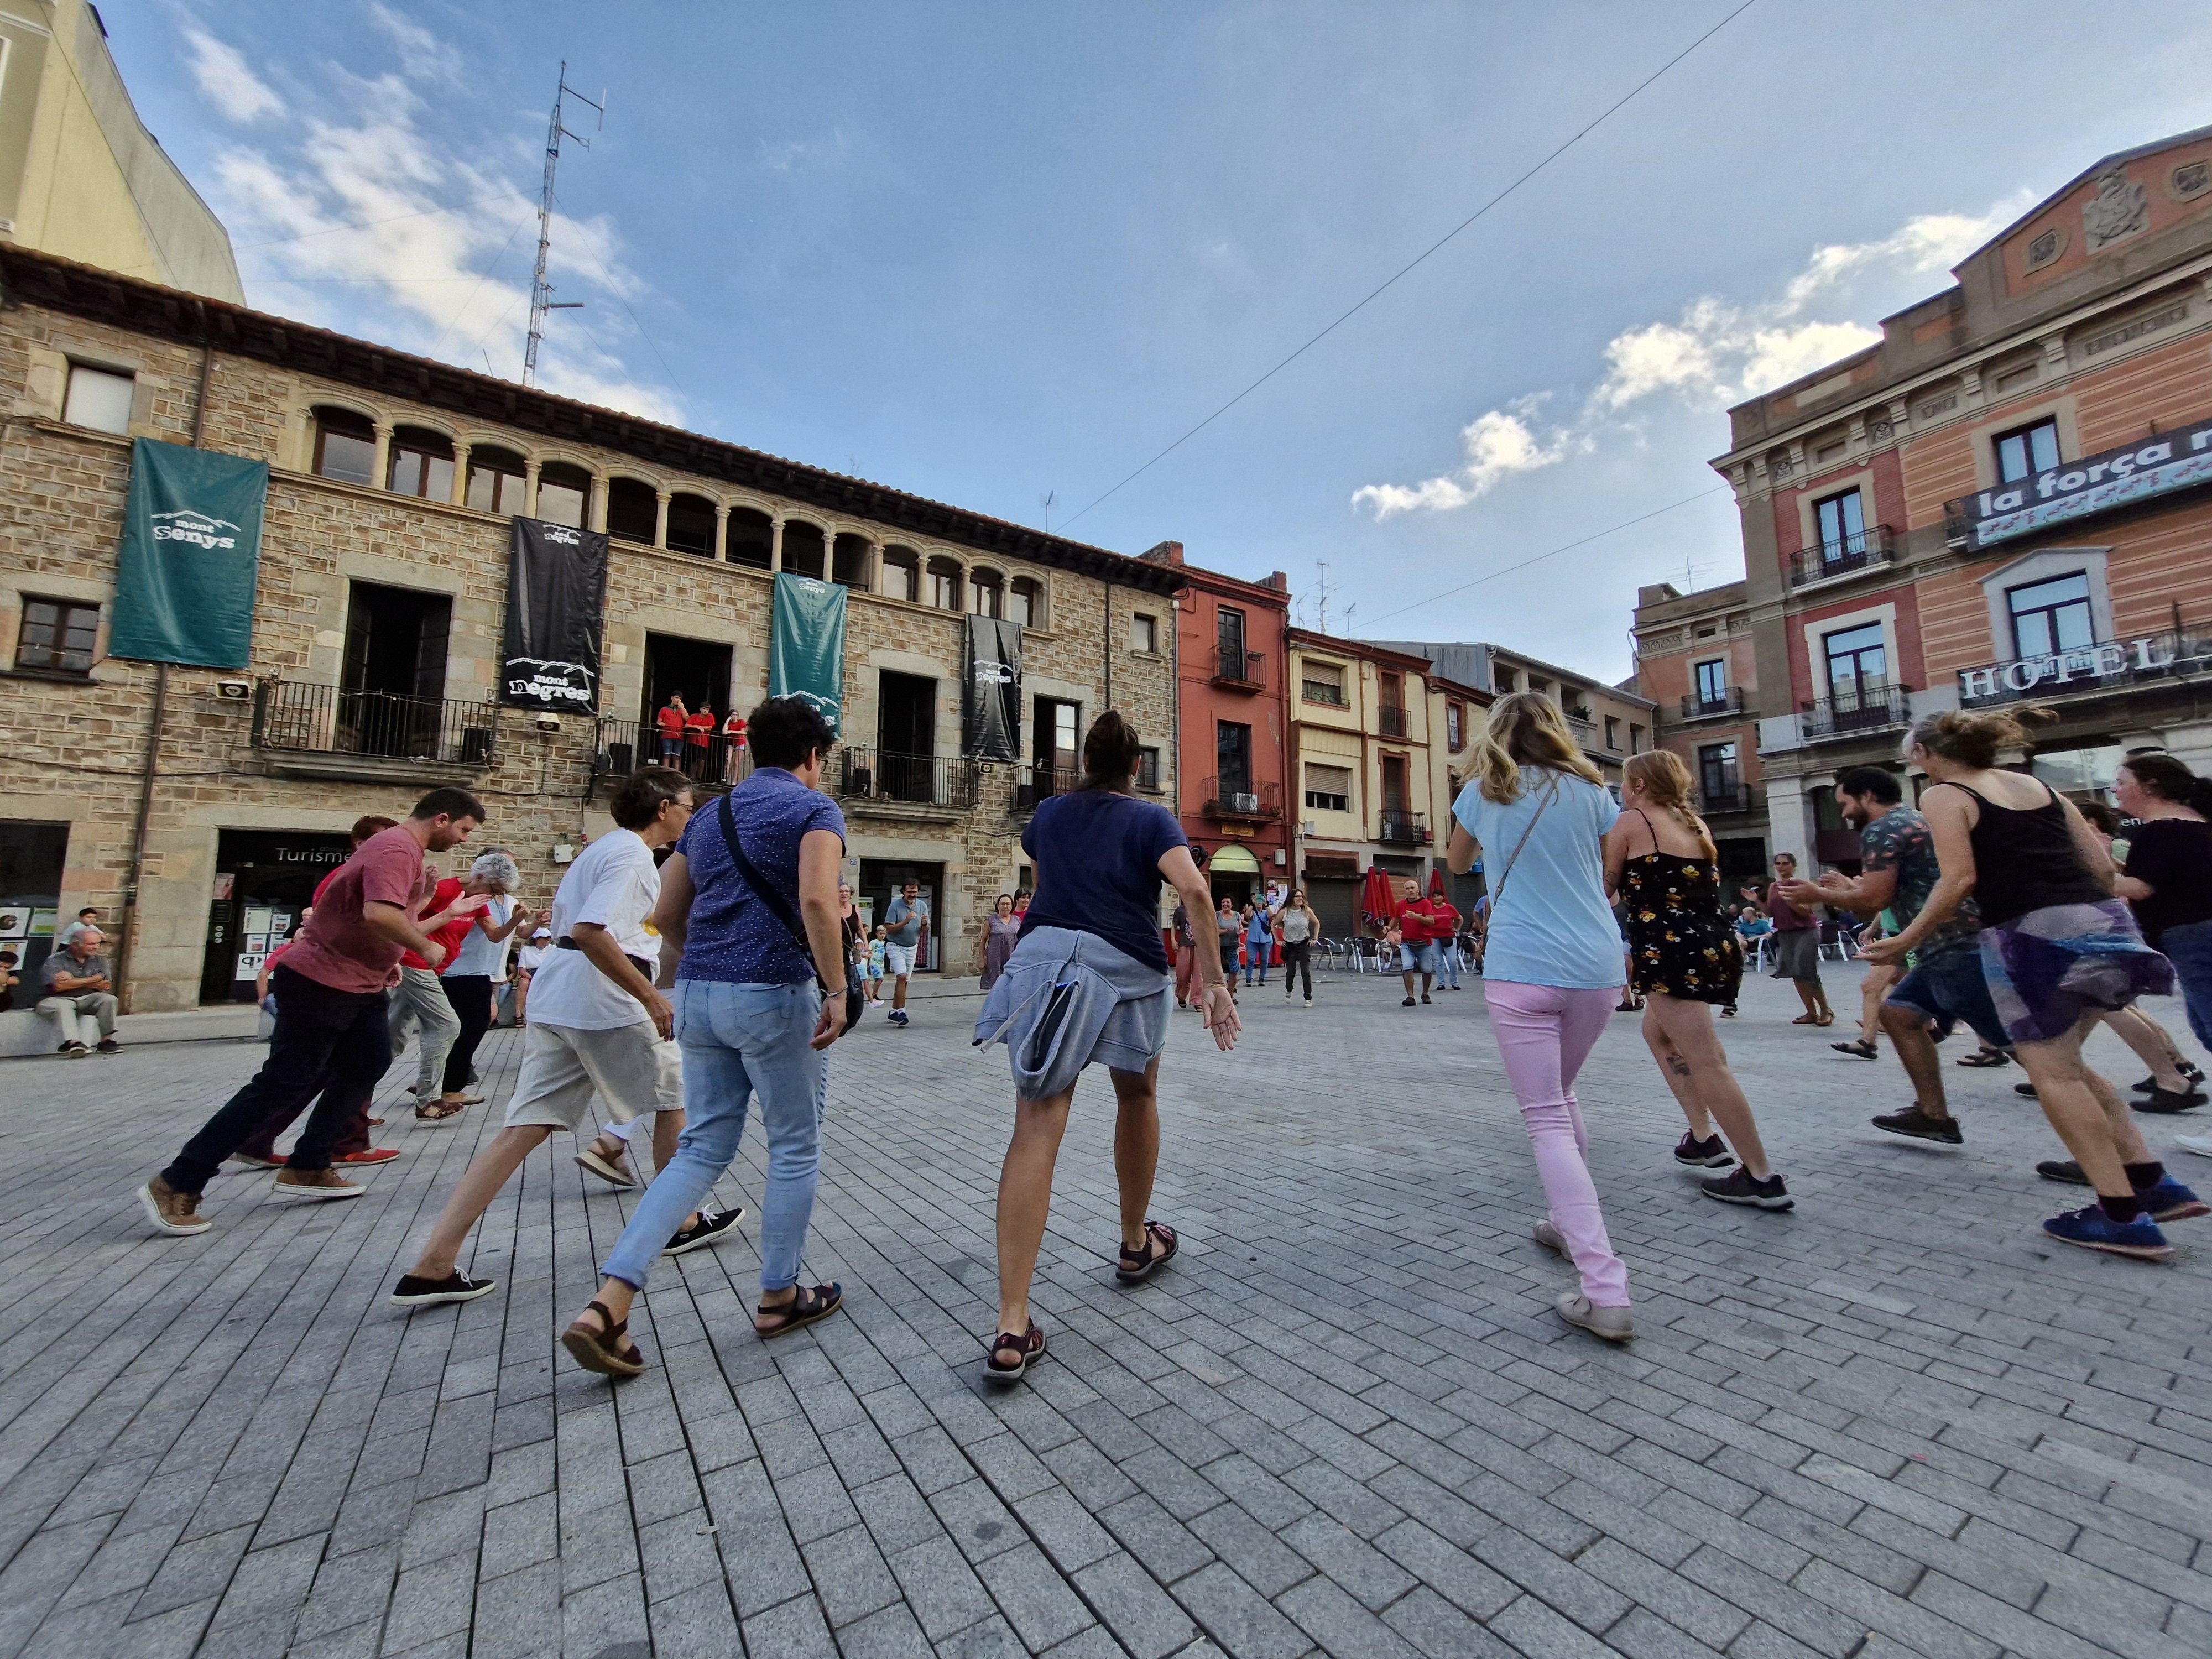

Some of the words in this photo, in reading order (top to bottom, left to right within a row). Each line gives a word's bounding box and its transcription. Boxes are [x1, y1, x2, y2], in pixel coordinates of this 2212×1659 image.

[1978, 489, 2023, 517] la
[2036, 442, 2171, 499] força
[175, 519, 215, 534] mont
[533, 674, 568, 686] mont
[1960, 638, 2176, 700] HOTEL
[508, 679, 590, 701] negres
